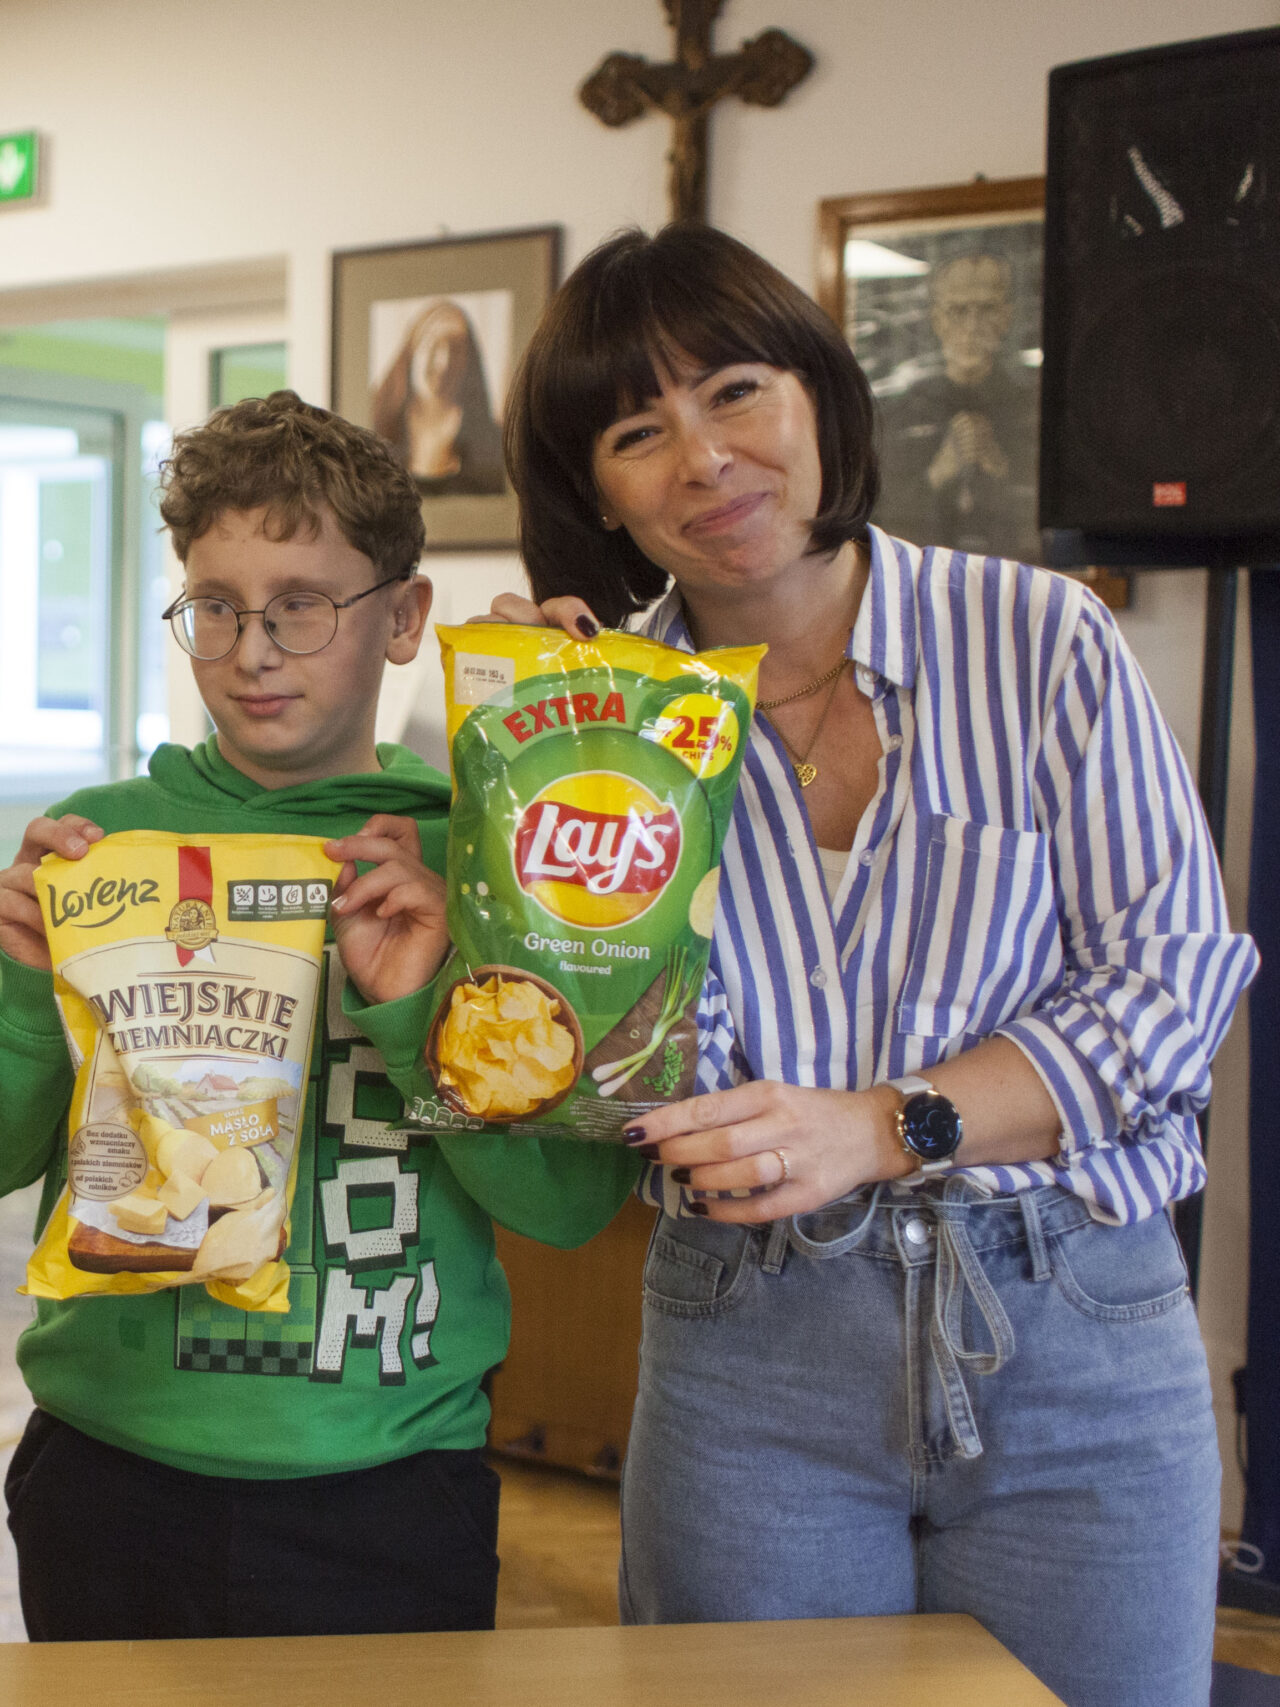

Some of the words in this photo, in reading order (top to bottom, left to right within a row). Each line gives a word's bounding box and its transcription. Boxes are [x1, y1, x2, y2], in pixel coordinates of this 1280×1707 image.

[502, 691, 626, 744] EXTRA
[523, 804, 673, 894] Lay's
[47, 876, 161, 928] Lorenz
[523, 932, 585, 954] Green
[591, 938, 650, 960] Onion
[559, 960, 612, 976] flavoured
[88, 981, 299, 1032] WIEJSKIE
